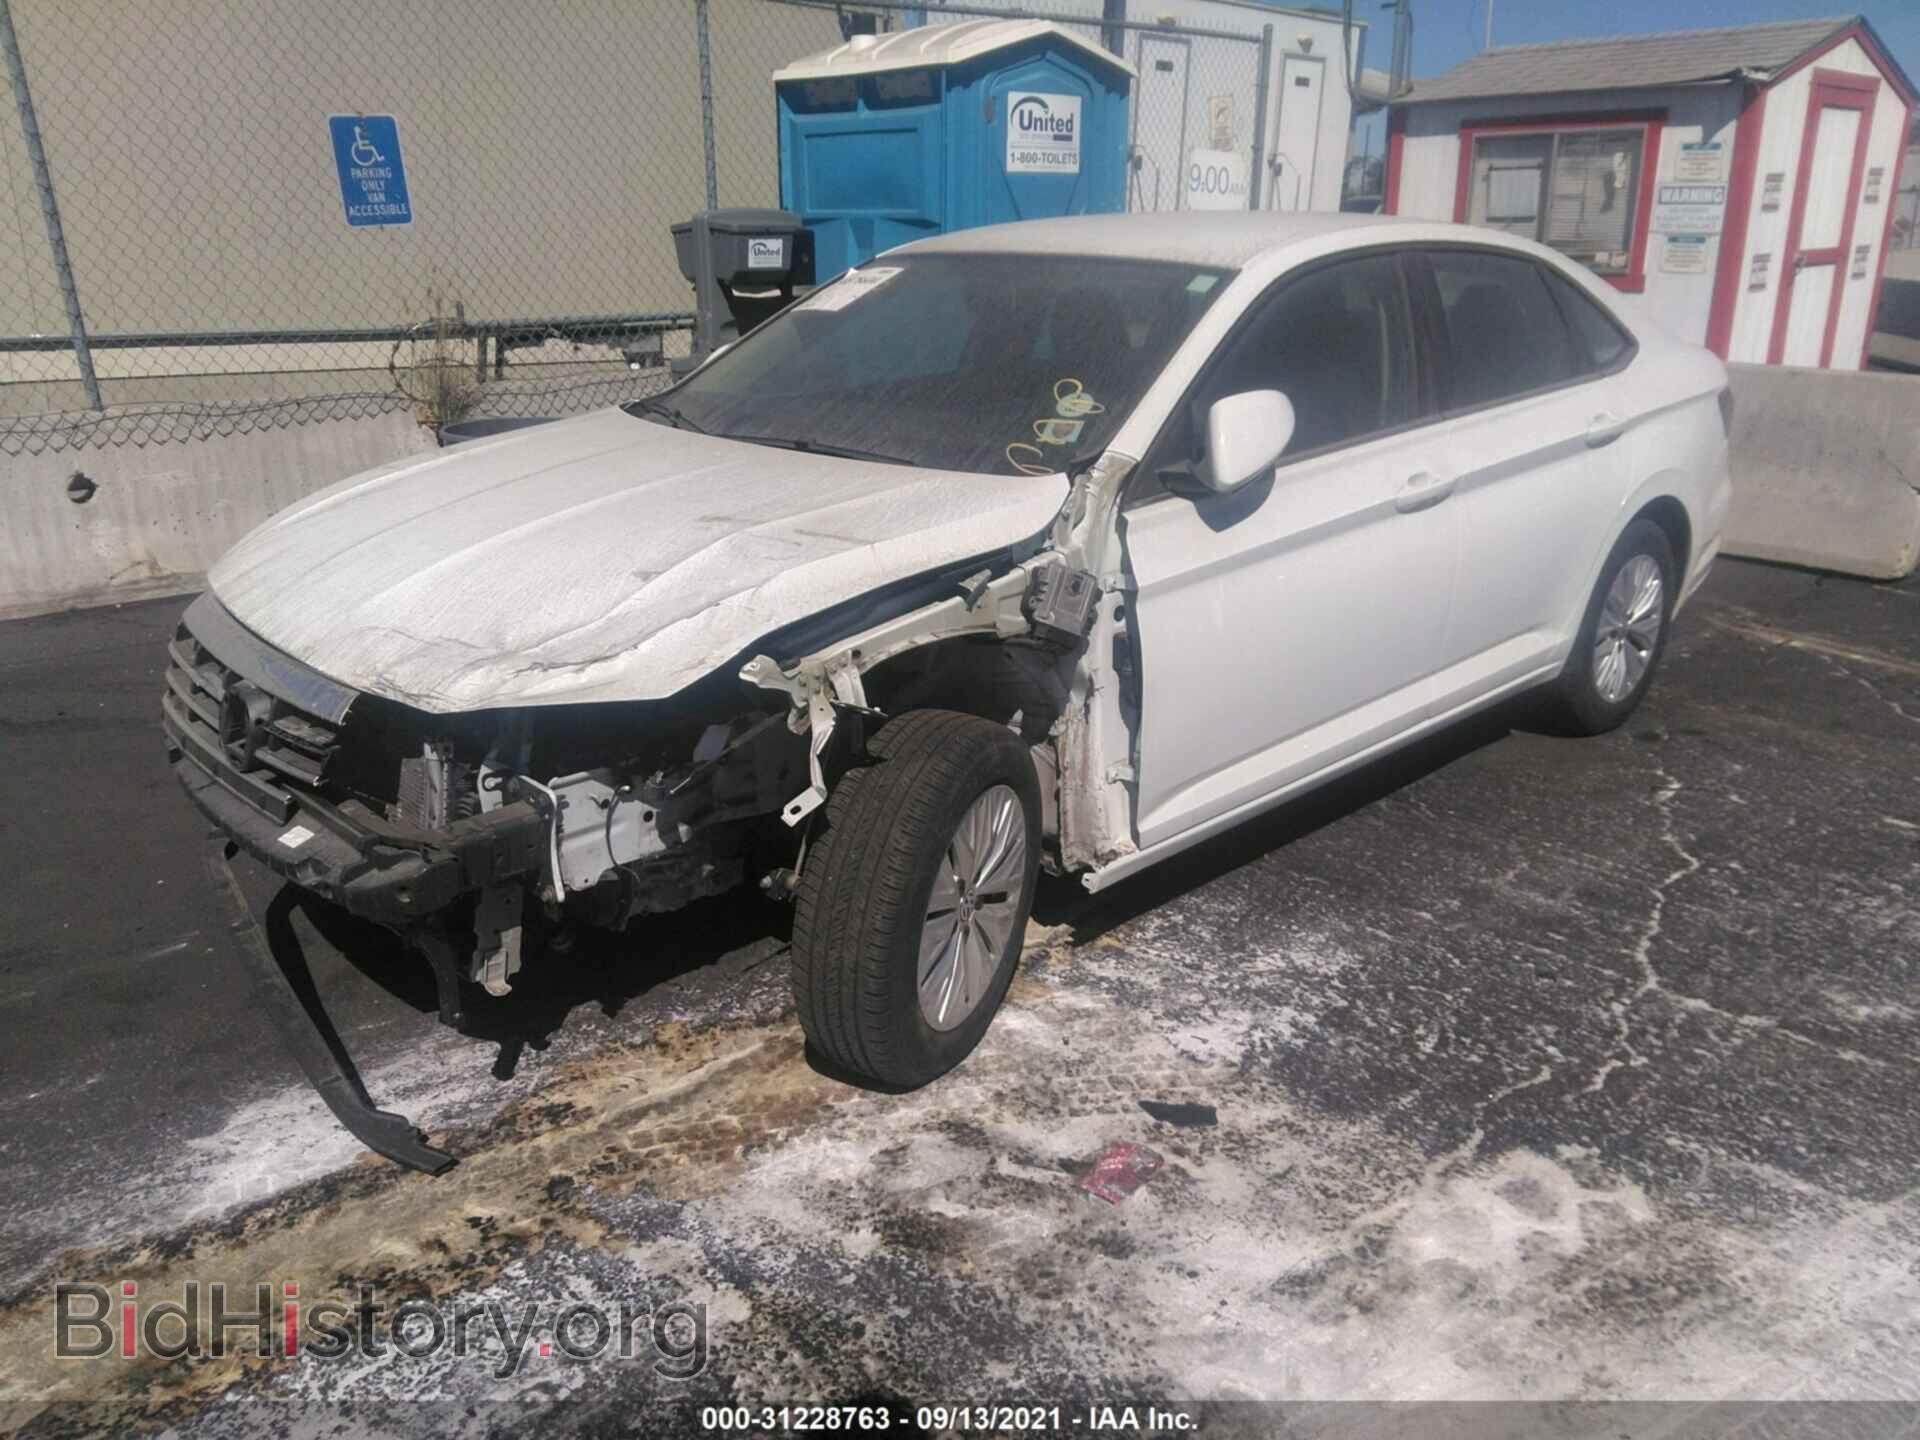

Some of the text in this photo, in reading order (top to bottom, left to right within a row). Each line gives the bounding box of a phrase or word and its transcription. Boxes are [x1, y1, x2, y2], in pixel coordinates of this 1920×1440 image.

[1018, 108, 1074, 133] United
[1009, 151, 1078, 166] 1-800-TOILETS
[350, 167, 392, 179] PARKING
[1190, 163, 1229, 195] 9:00
[361, 179, 385, 192] ONLY
[367, 191, 386, 203] VAN
[349, 203, 408, 216] ACCESSIBLE
